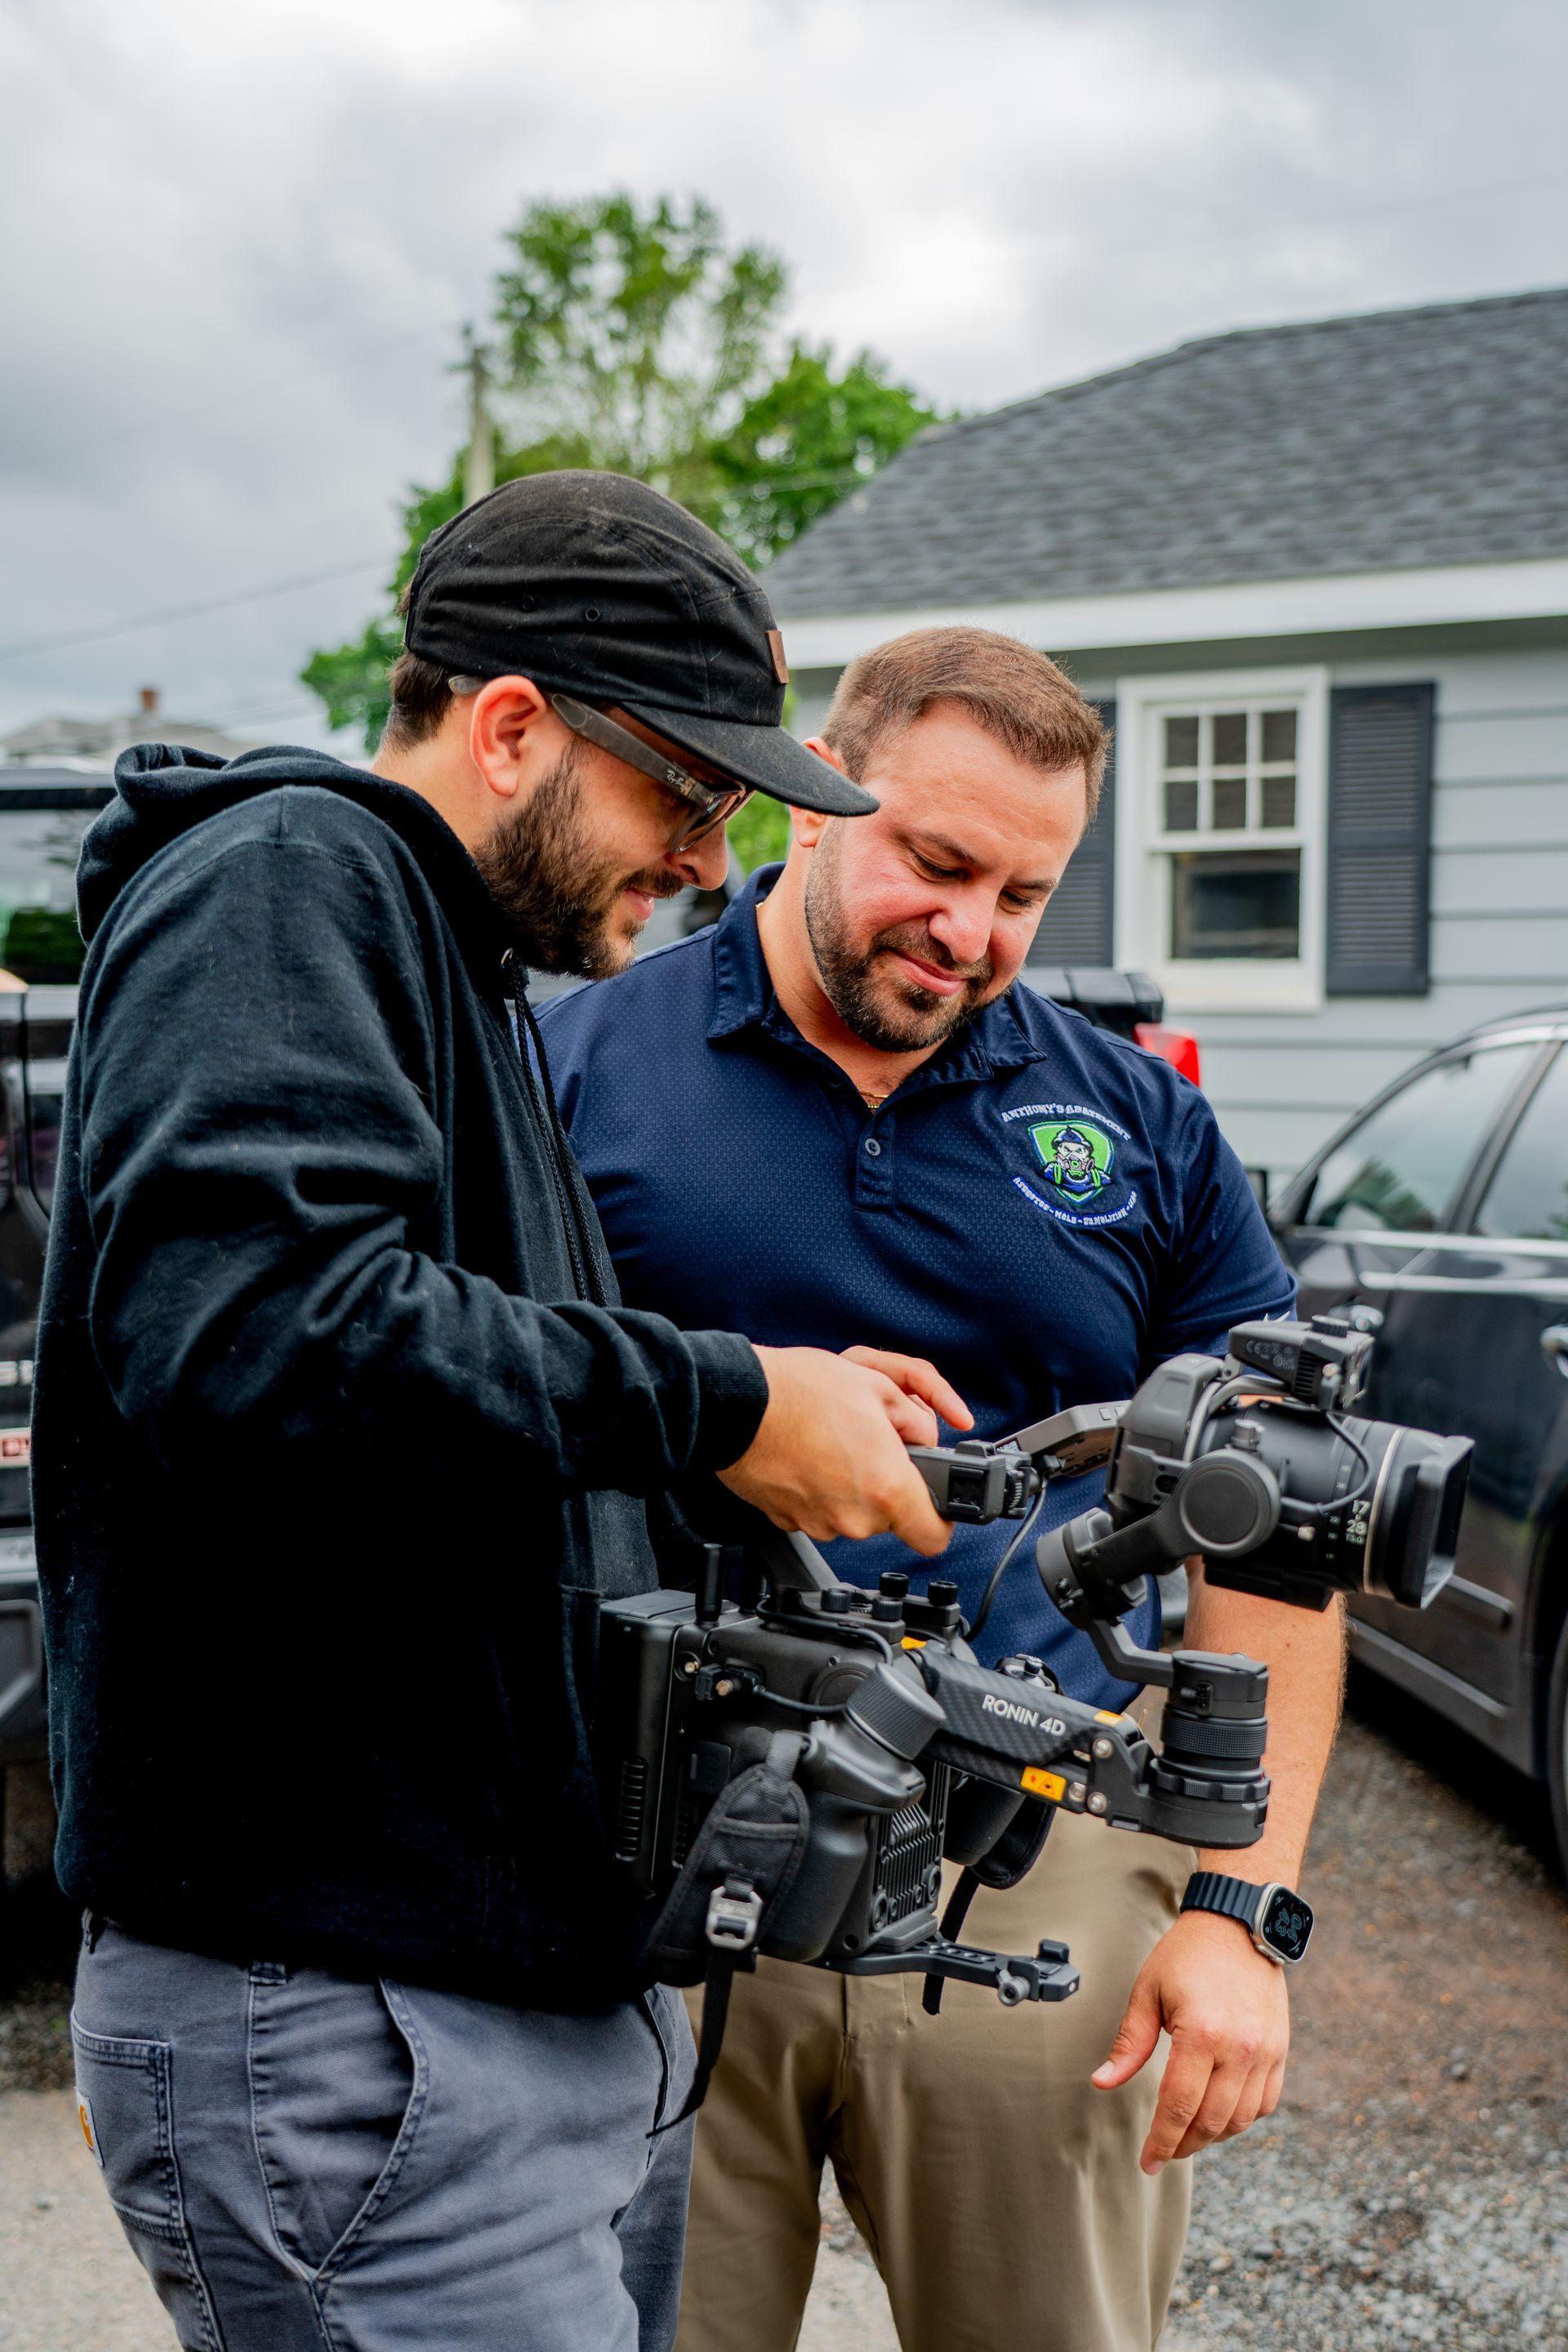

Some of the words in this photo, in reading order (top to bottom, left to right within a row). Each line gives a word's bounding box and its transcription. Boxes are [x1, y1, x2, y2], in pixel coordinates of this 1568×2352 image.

[1001, 1102, 1065, 1122] ANTHONY'S
[1065, 1104, 1132, 1141] ABATEMENT
[1083, 1208, 1129, 1226] DEMOLITION
[1352, 1499, 1371, 1515] 17
[1346, 1519, 1367, 1535] 28
[982, 1694, 1039, 1728] RONIN
[1040, 1717, 1067, 1736] 4D
